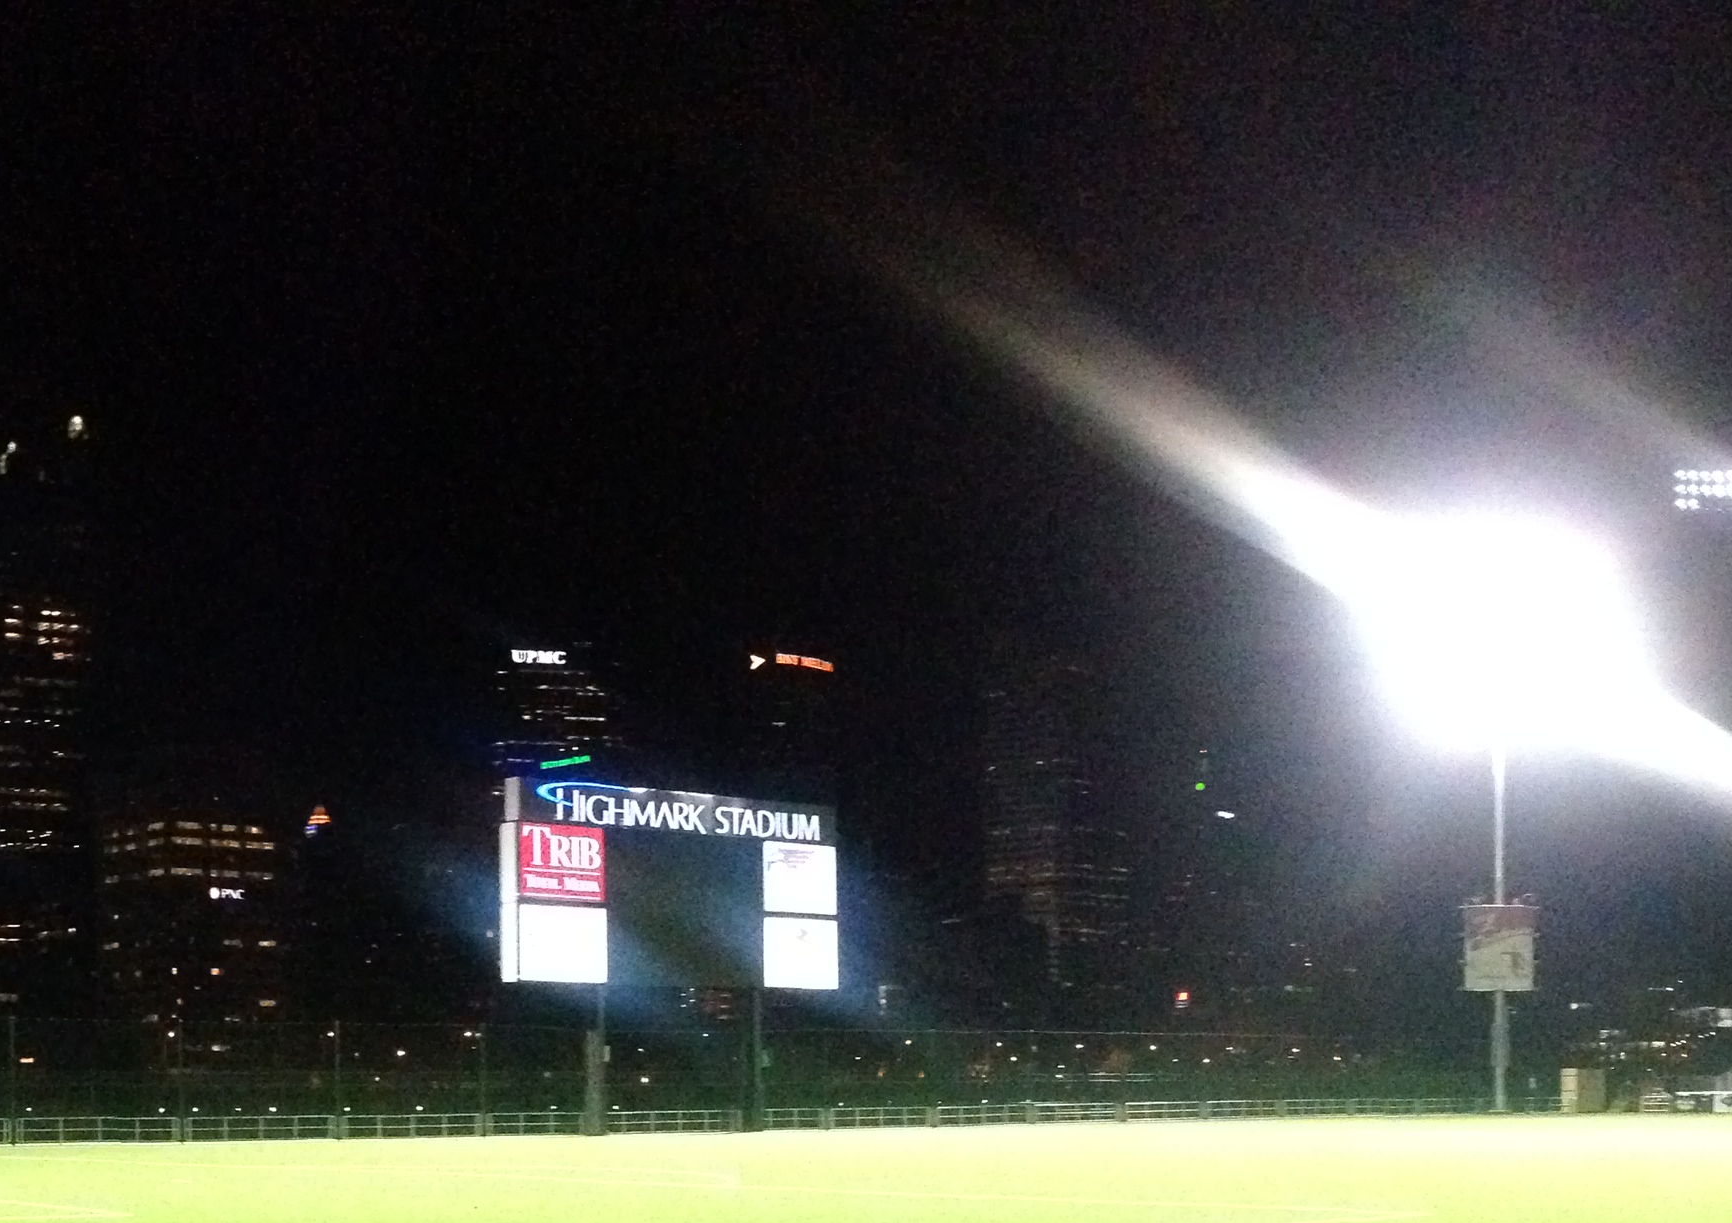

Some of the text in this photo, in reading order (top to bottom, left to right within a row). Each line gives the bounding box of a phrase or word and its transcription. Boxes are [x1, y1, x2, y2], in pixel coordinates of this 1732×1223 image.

[511, 650, 567, 664] UPMC
[554, 787, 820, 841] HIGHMARK STADIUM
[522, 825, 602, 870] TRIB
[221, 888, 245, 899] PNC
